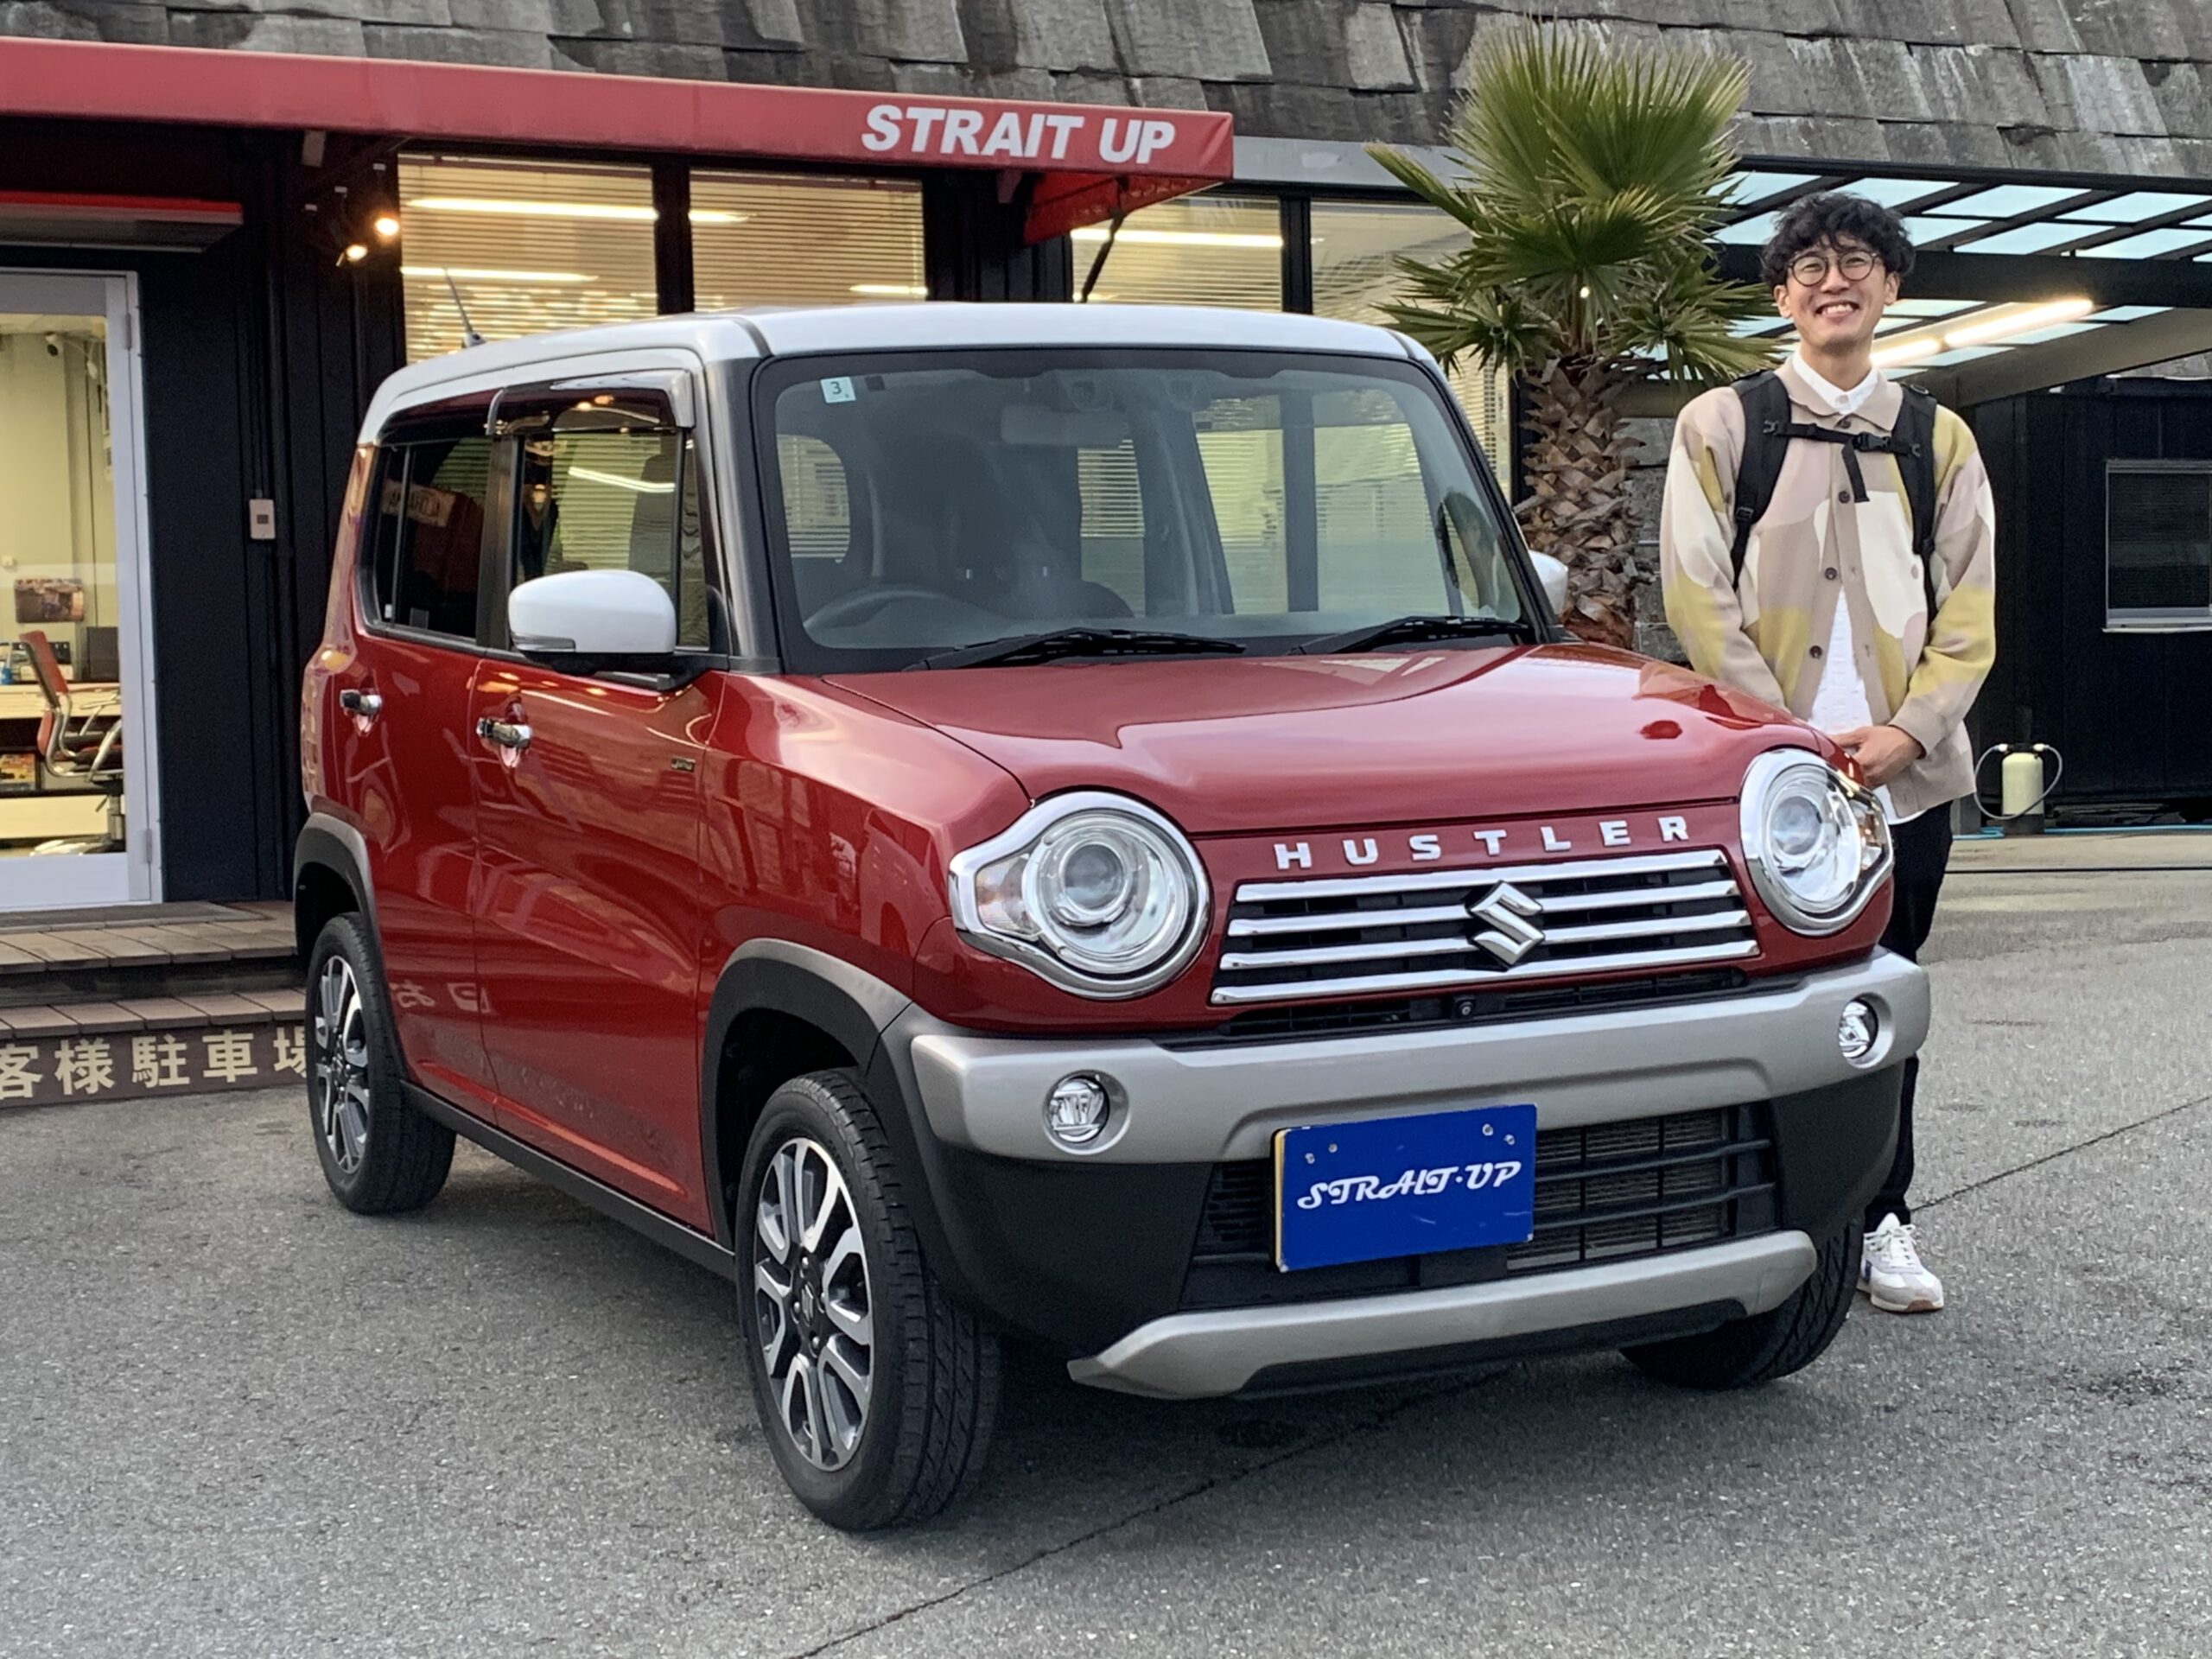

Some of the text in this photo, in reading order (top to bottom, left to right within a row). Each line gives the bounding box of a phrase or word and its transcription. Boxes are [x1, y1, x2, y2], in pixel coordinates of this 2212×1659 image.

[861, 105, 1176, 164] STRAIT UP
[830, 381, 842, 395] 3
[1274, 816, 1689, 869] HUSTLER
